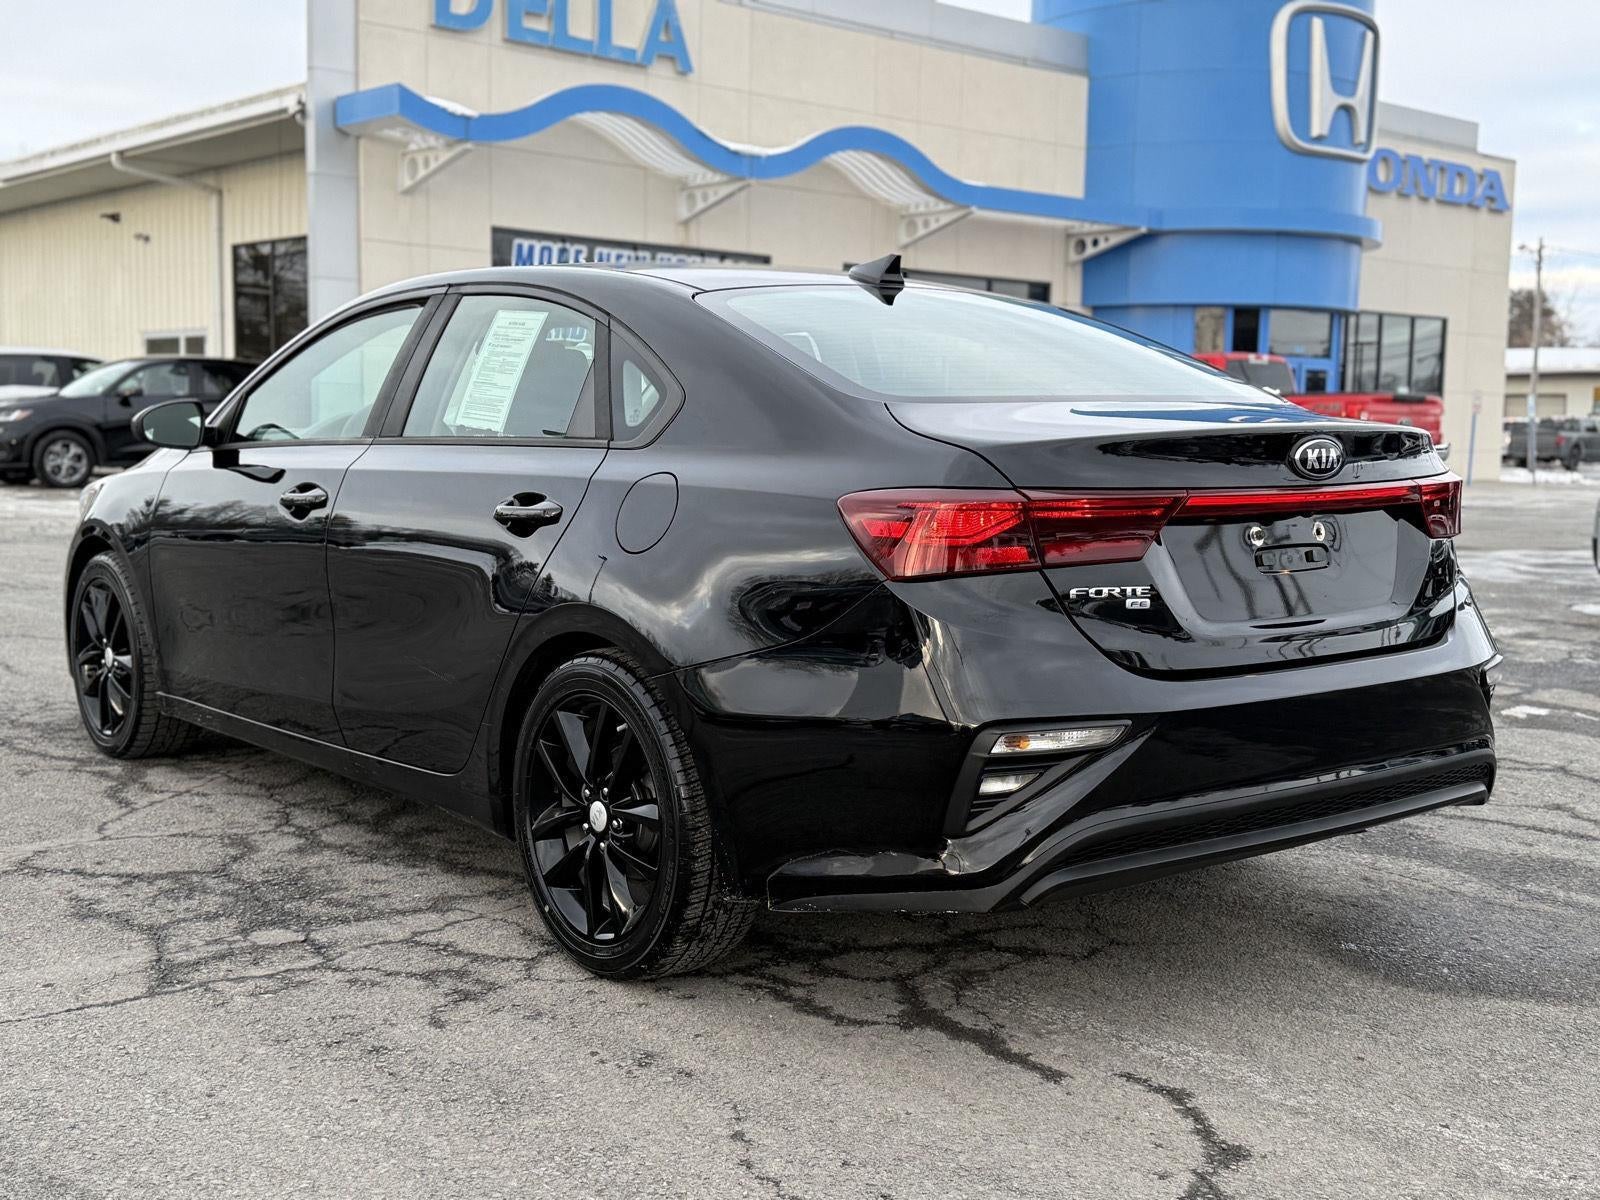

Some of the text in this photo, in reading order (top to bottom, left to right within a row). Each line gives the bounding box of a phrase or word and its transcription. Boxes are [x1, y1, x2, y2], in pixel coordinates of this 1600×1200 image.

[1367, 147, 1511, 213] ONDA
[1306, 447, 1338, 470] KIA
[1069, 586, 1151, 599] FORTE
[1129, 600, 1149, 609] FE
